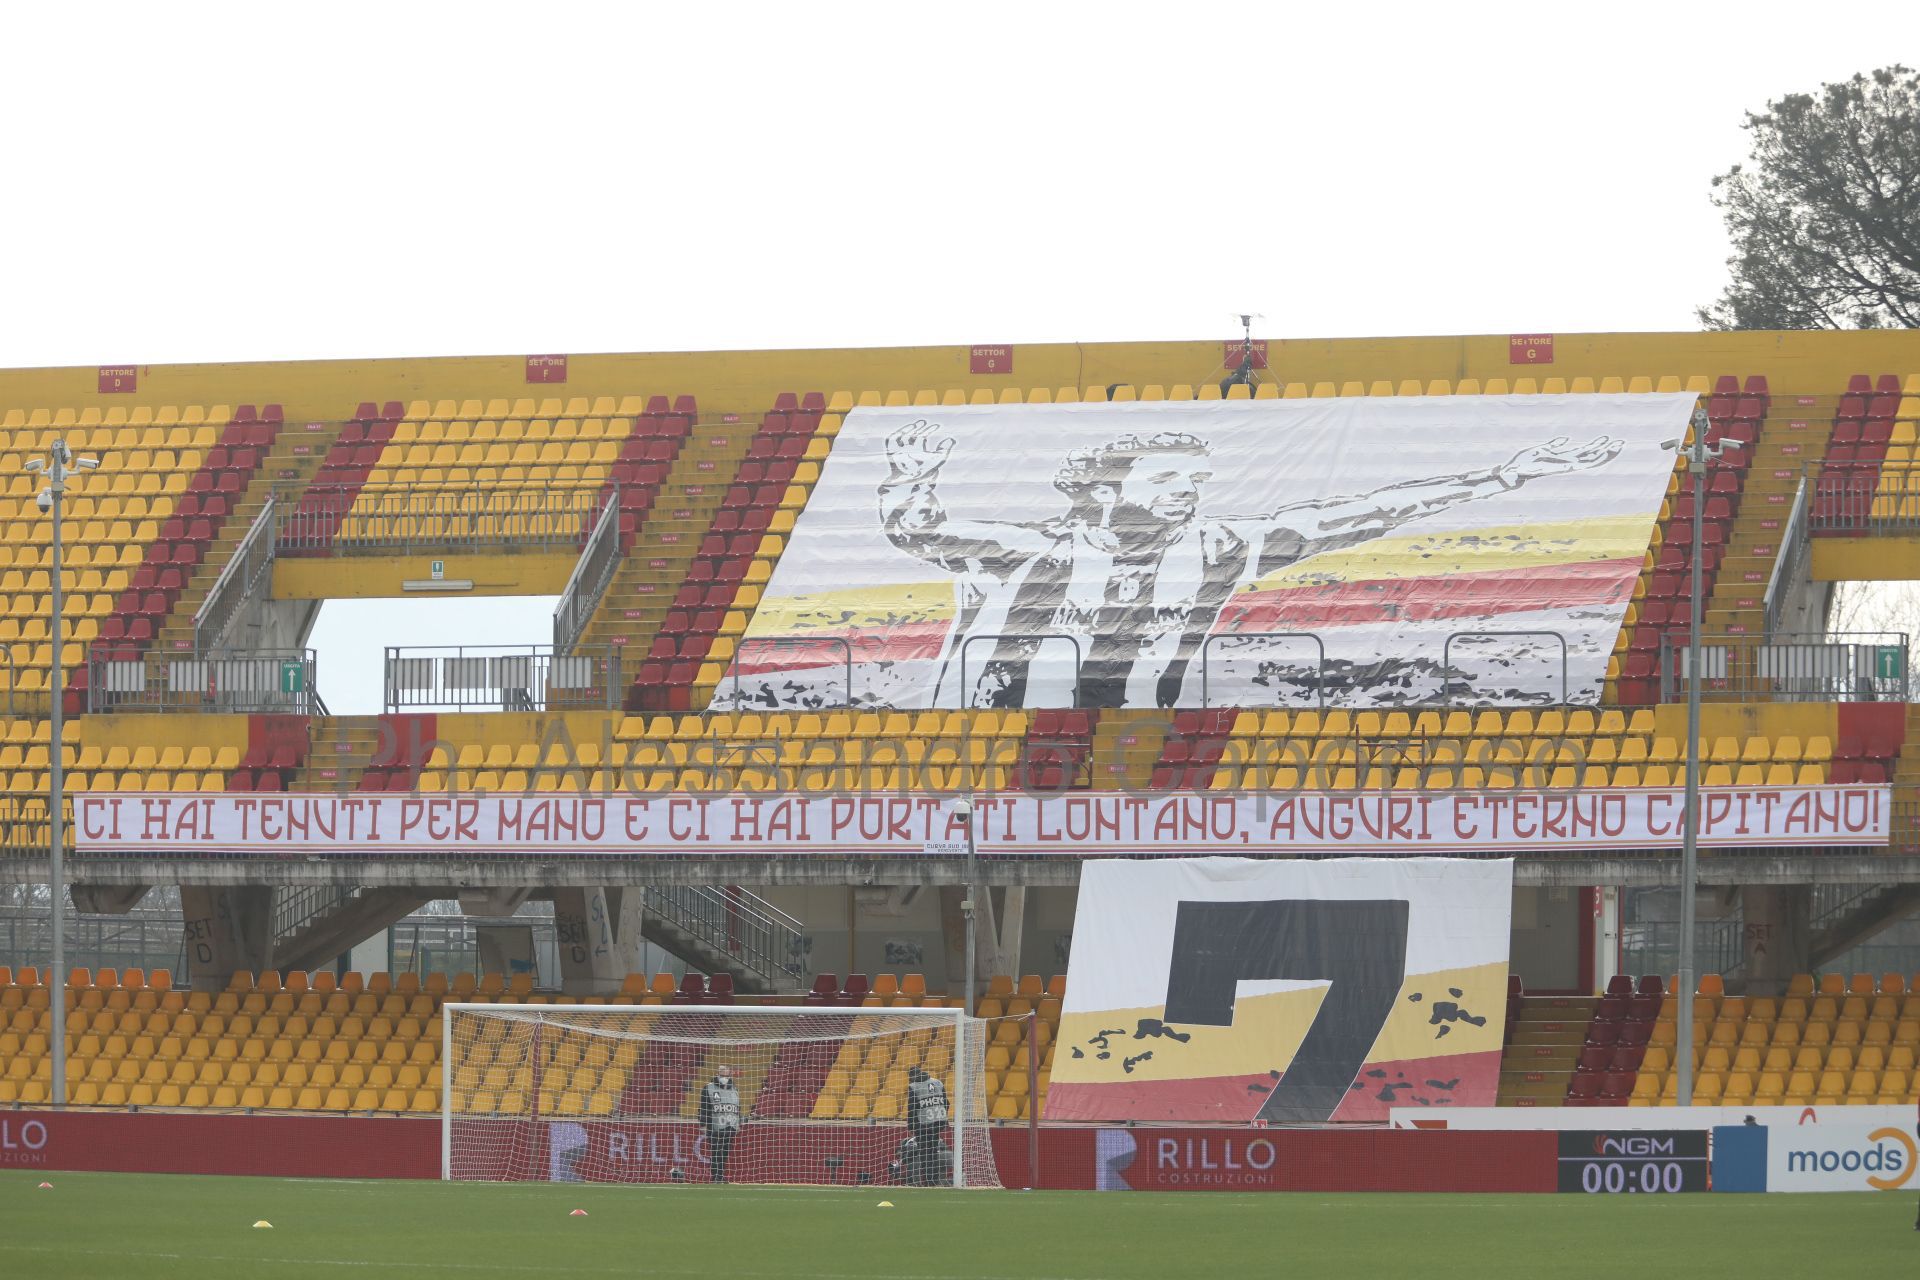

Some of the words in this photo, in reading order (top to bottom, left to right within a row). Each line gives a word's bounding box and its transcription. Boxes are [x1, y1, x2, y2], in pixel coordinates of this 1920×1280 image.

[83, 799, 122, 840] CI
[140, 799, 216, 840] HAI
[400, 799, 479, 840] PER
[498, 799, 605, 841] MANO
[624, 799, 649, 841] E
[668, 799, 710, 841] CI
[730, 799, 811, 841] HAI
[1453, 795, 1627, 840] ETERNO
[186, 918, 212, 940] SET
[1163, 900, 1409, 1121] 7
[1158, 1138, 1276, 1169] RILLO
[1602, 1137, 1674, 1155] NGM
[1788, 1143, 1903, 1172] moods
[1157, 1173, 1274, 1184] COSTRUZIONI
[1582, 1162, 1682, 1193] 00:00
